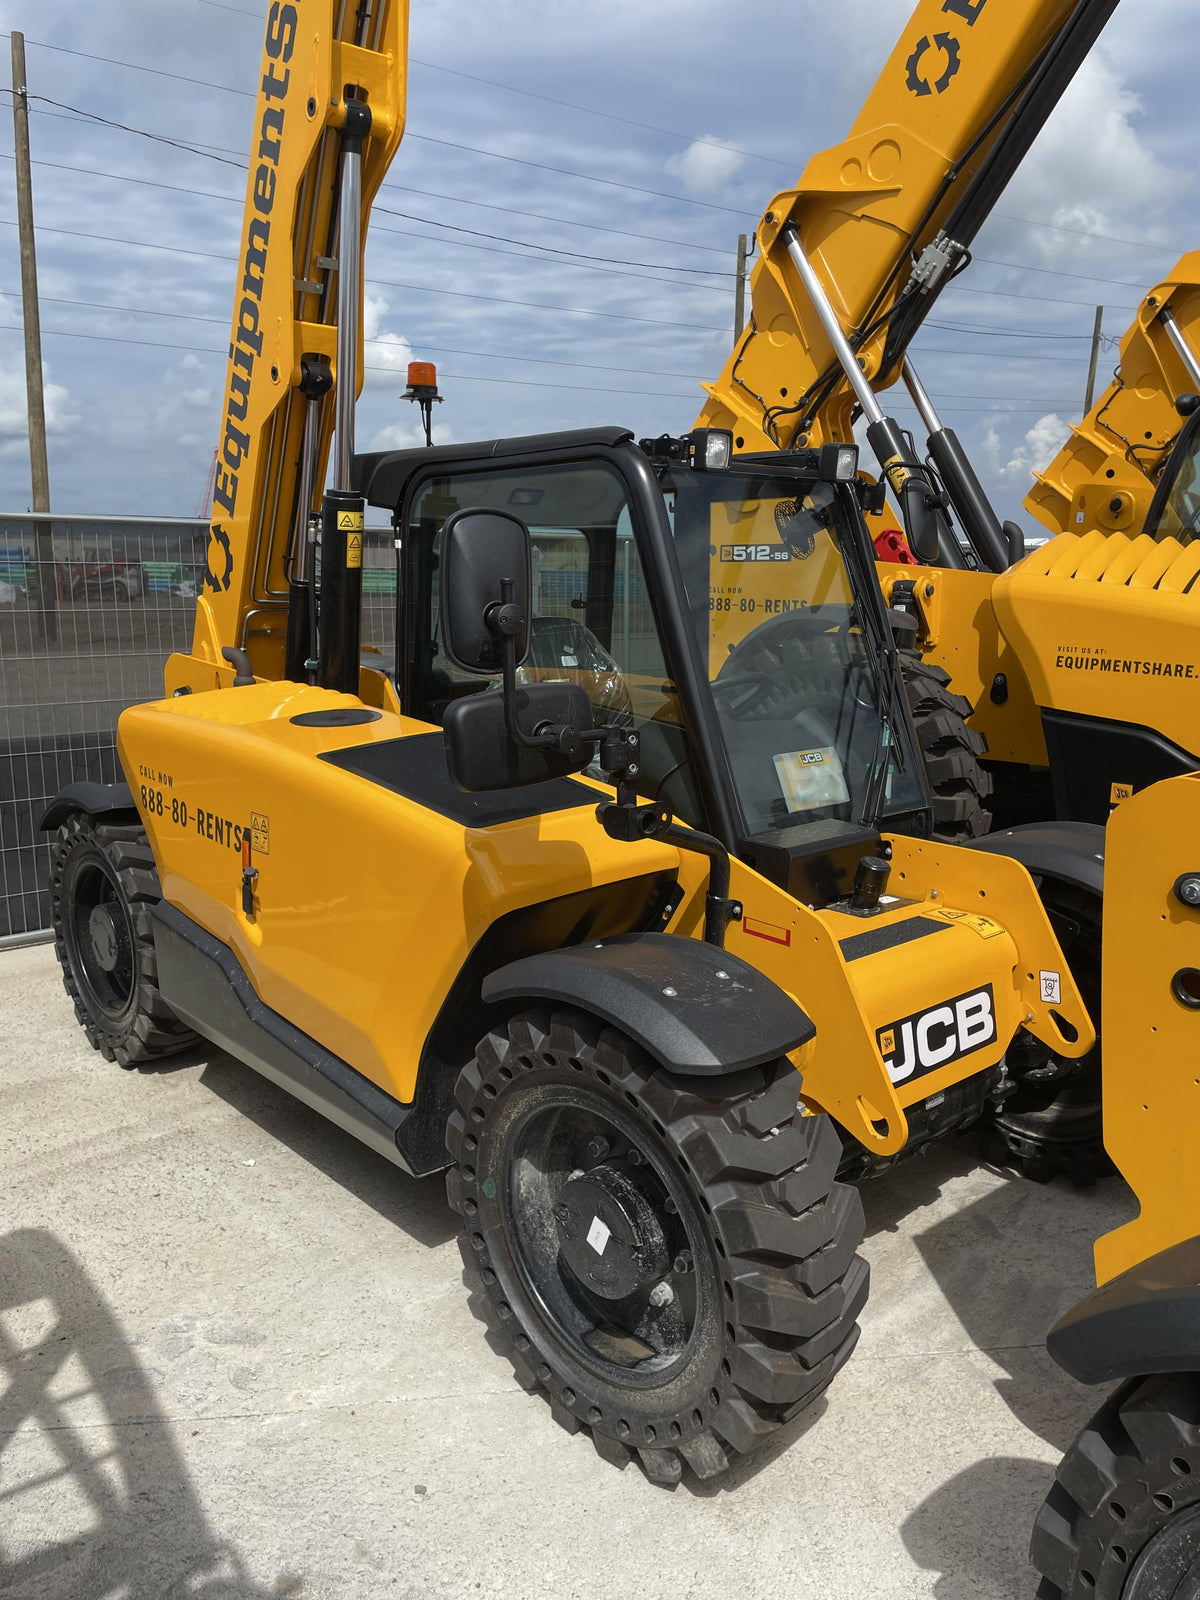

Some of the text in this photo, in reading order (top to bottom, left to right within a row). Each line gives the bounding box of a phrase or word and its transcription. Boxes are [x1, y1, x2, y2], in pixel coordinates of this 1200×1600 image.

[213, 0, 300, 520] EquipmentS
[1056, 655, 1199, 679] EQUIPMENTSHARE.
[139, 765, 173, 788] CALL NOW
[801, 753, 823, 764] JCB
[140, 785, 242, 853] 888-80-RENTS
[884, 992, 994, 1083] JCB
